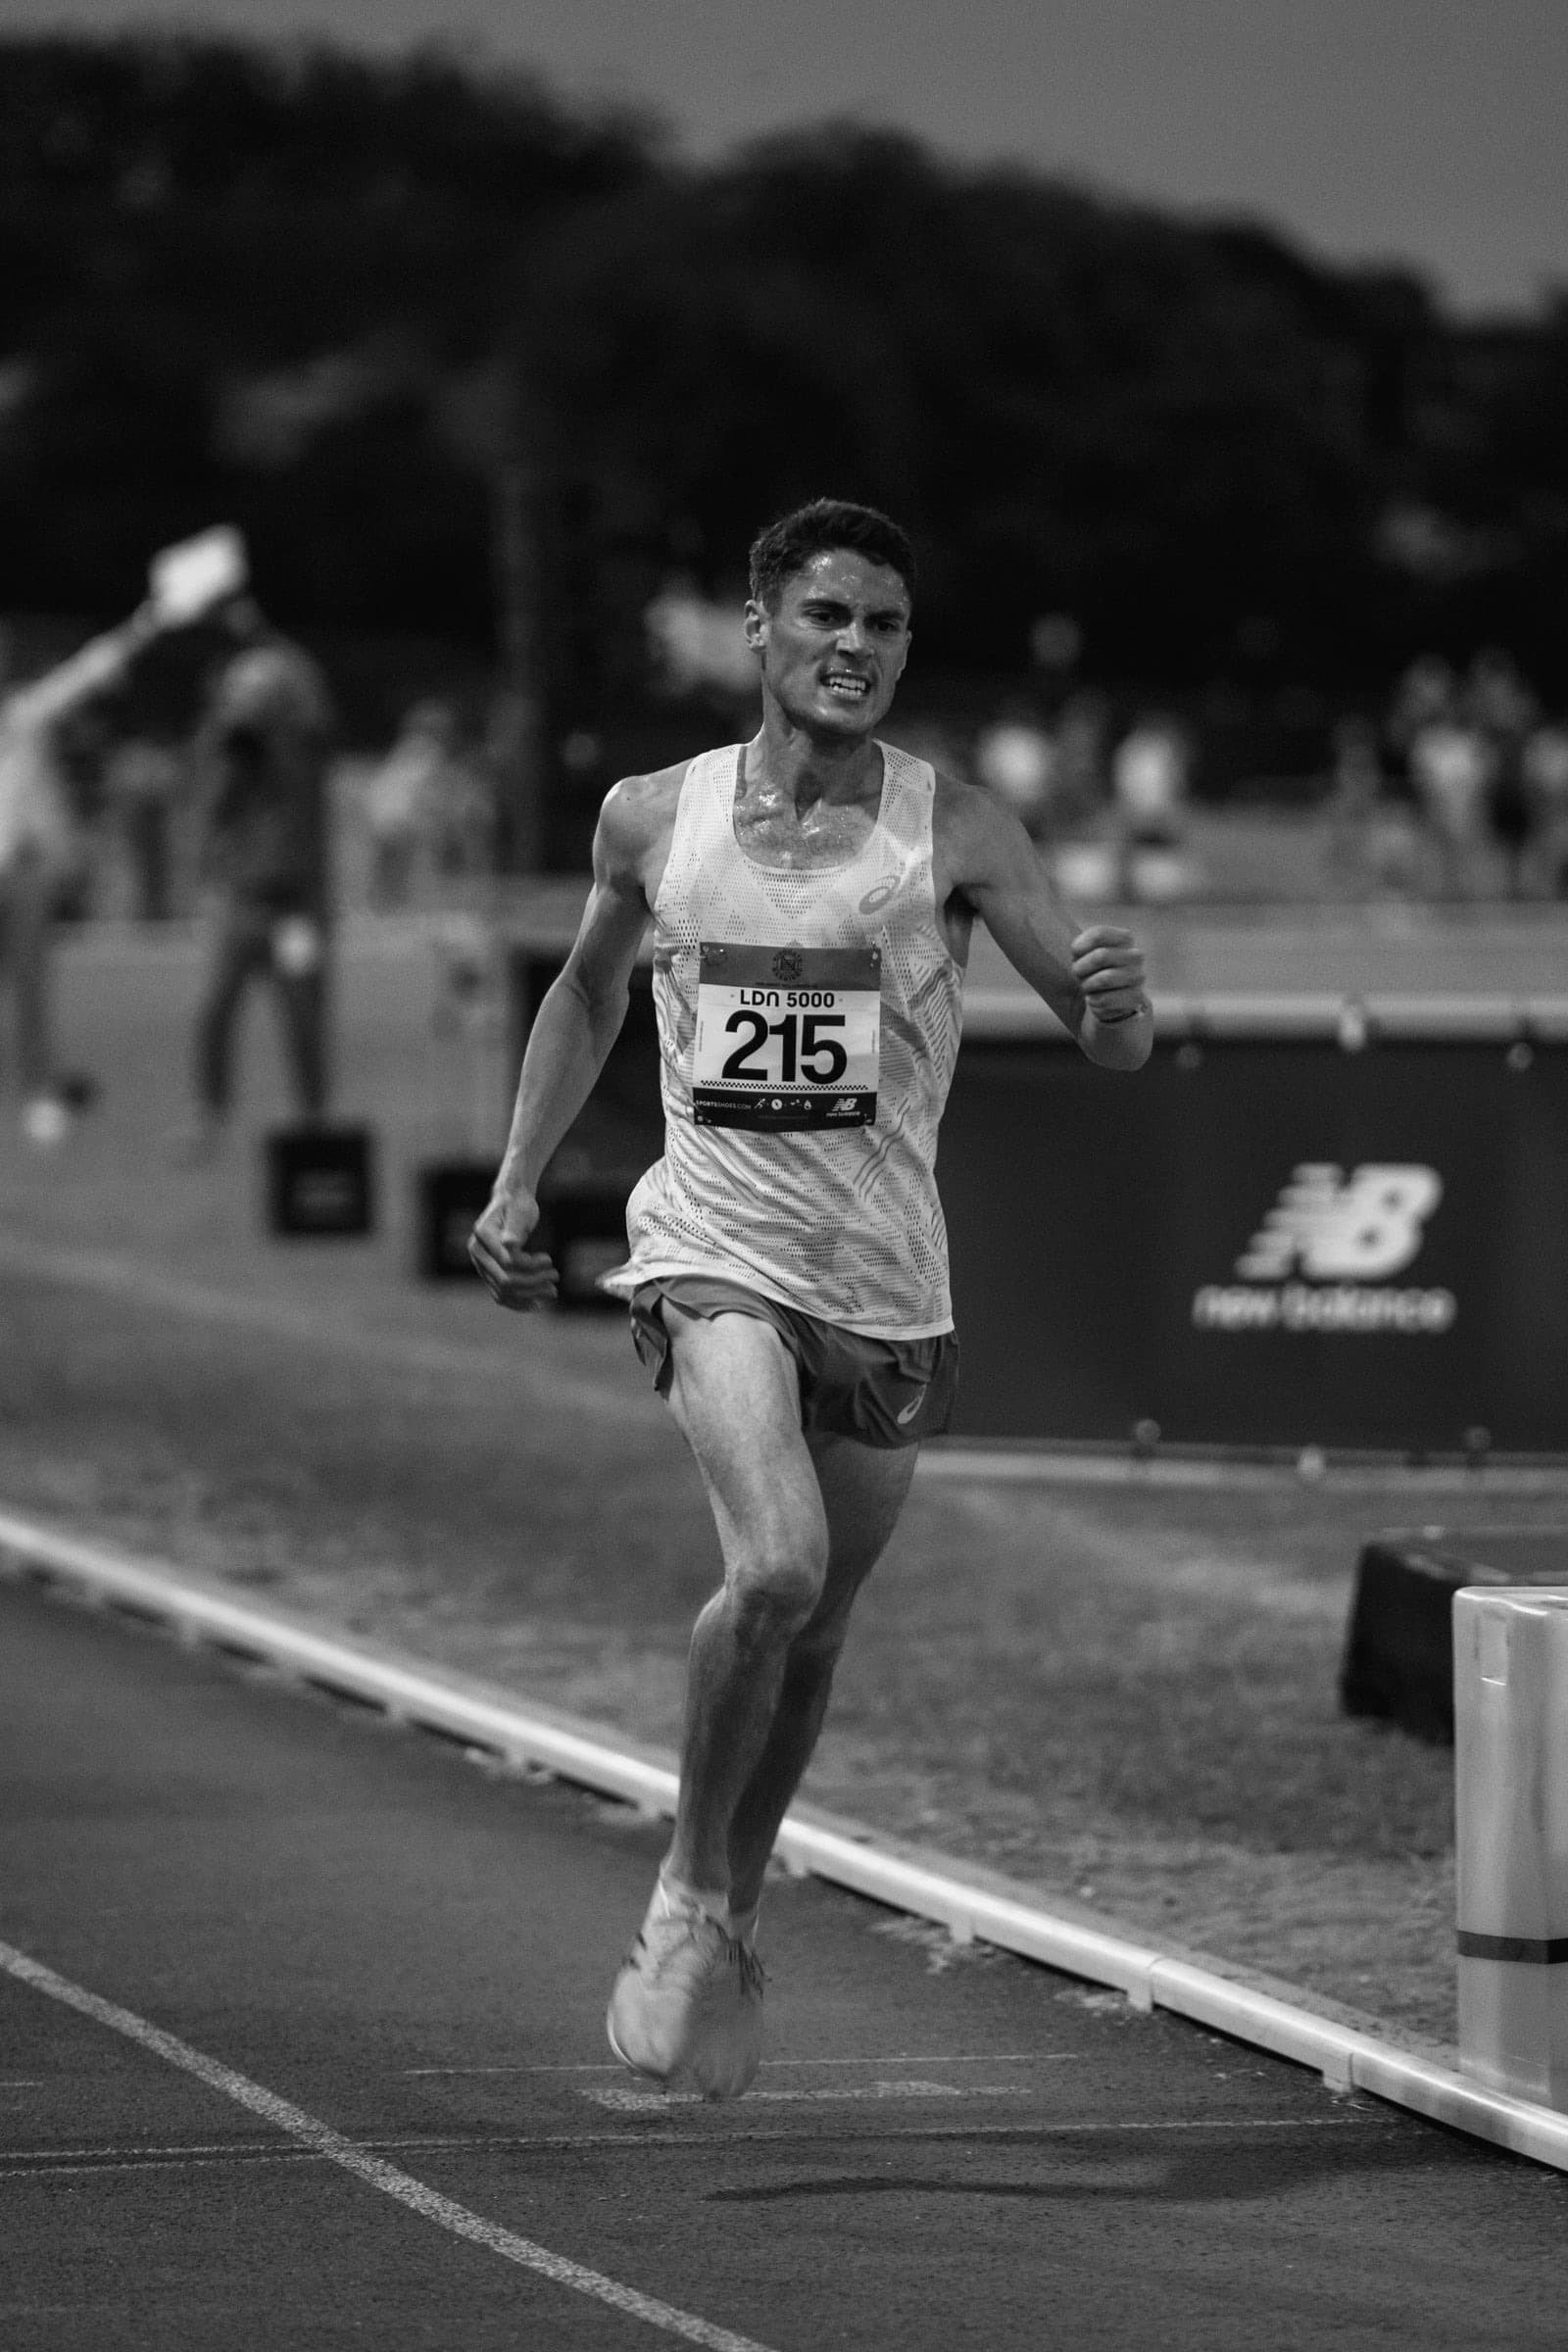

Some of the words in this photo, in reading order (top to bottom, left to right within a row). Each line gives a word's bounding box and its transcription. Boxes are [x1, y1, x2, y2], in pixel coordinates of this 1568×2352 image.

[786, 992, 835, 1008] 5000
[721, 1009, 848, 1085] 215
[1194, 1285, 1273, 1331] new
[1278, 1282, 1457, 1333] balance
